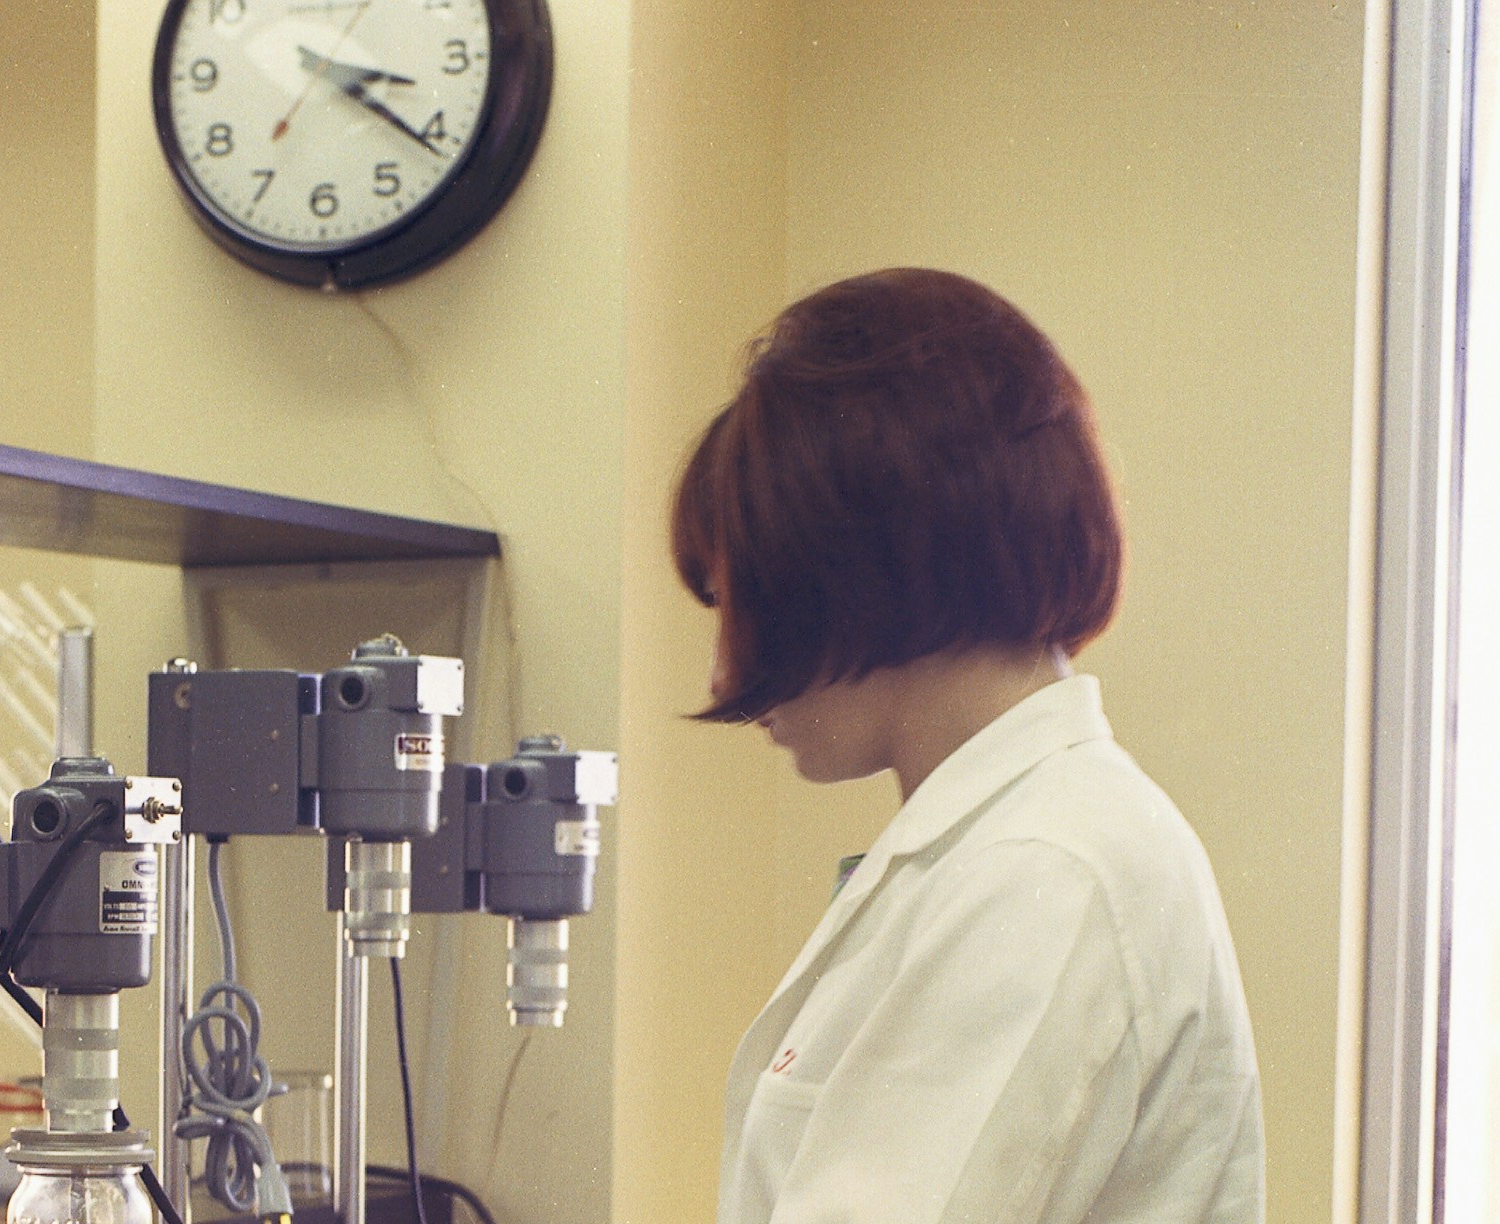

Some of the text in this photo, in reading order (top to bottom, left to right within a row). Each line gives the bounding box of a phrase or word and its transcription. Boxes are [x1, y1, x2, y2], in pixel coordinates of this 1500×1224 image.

[442, 40, 470, 75] 3
[191, 58, 218, 92] 9
[206, 123, 234, 157] 8
[420, 111, 447, 143] 4
[252, 170, 276, 202] 7
[373, 162, 400, 198] 5
[309, 183, 340, 218] 6
